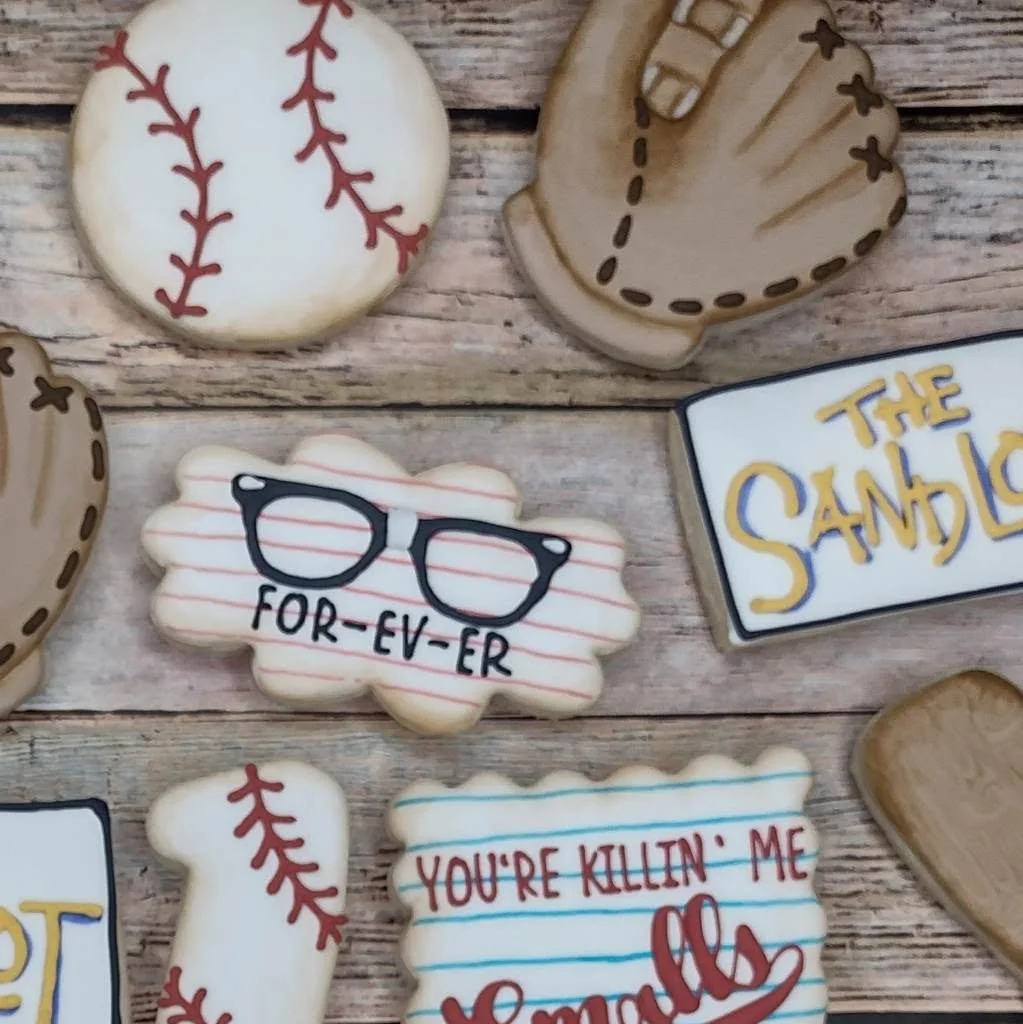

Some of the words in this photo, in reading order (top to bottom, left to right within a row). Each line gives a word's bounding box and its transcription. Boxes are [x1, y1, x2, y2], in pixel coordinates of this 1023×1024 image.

[815, 364, 971, 449] THE
[251, 584, 512, 678] FOR-EV-ER
[416, 846, 560, 911] YOU'RE
[579, 833, 725, 898] KILLIN'
[749, 826, 808, 882] ME
